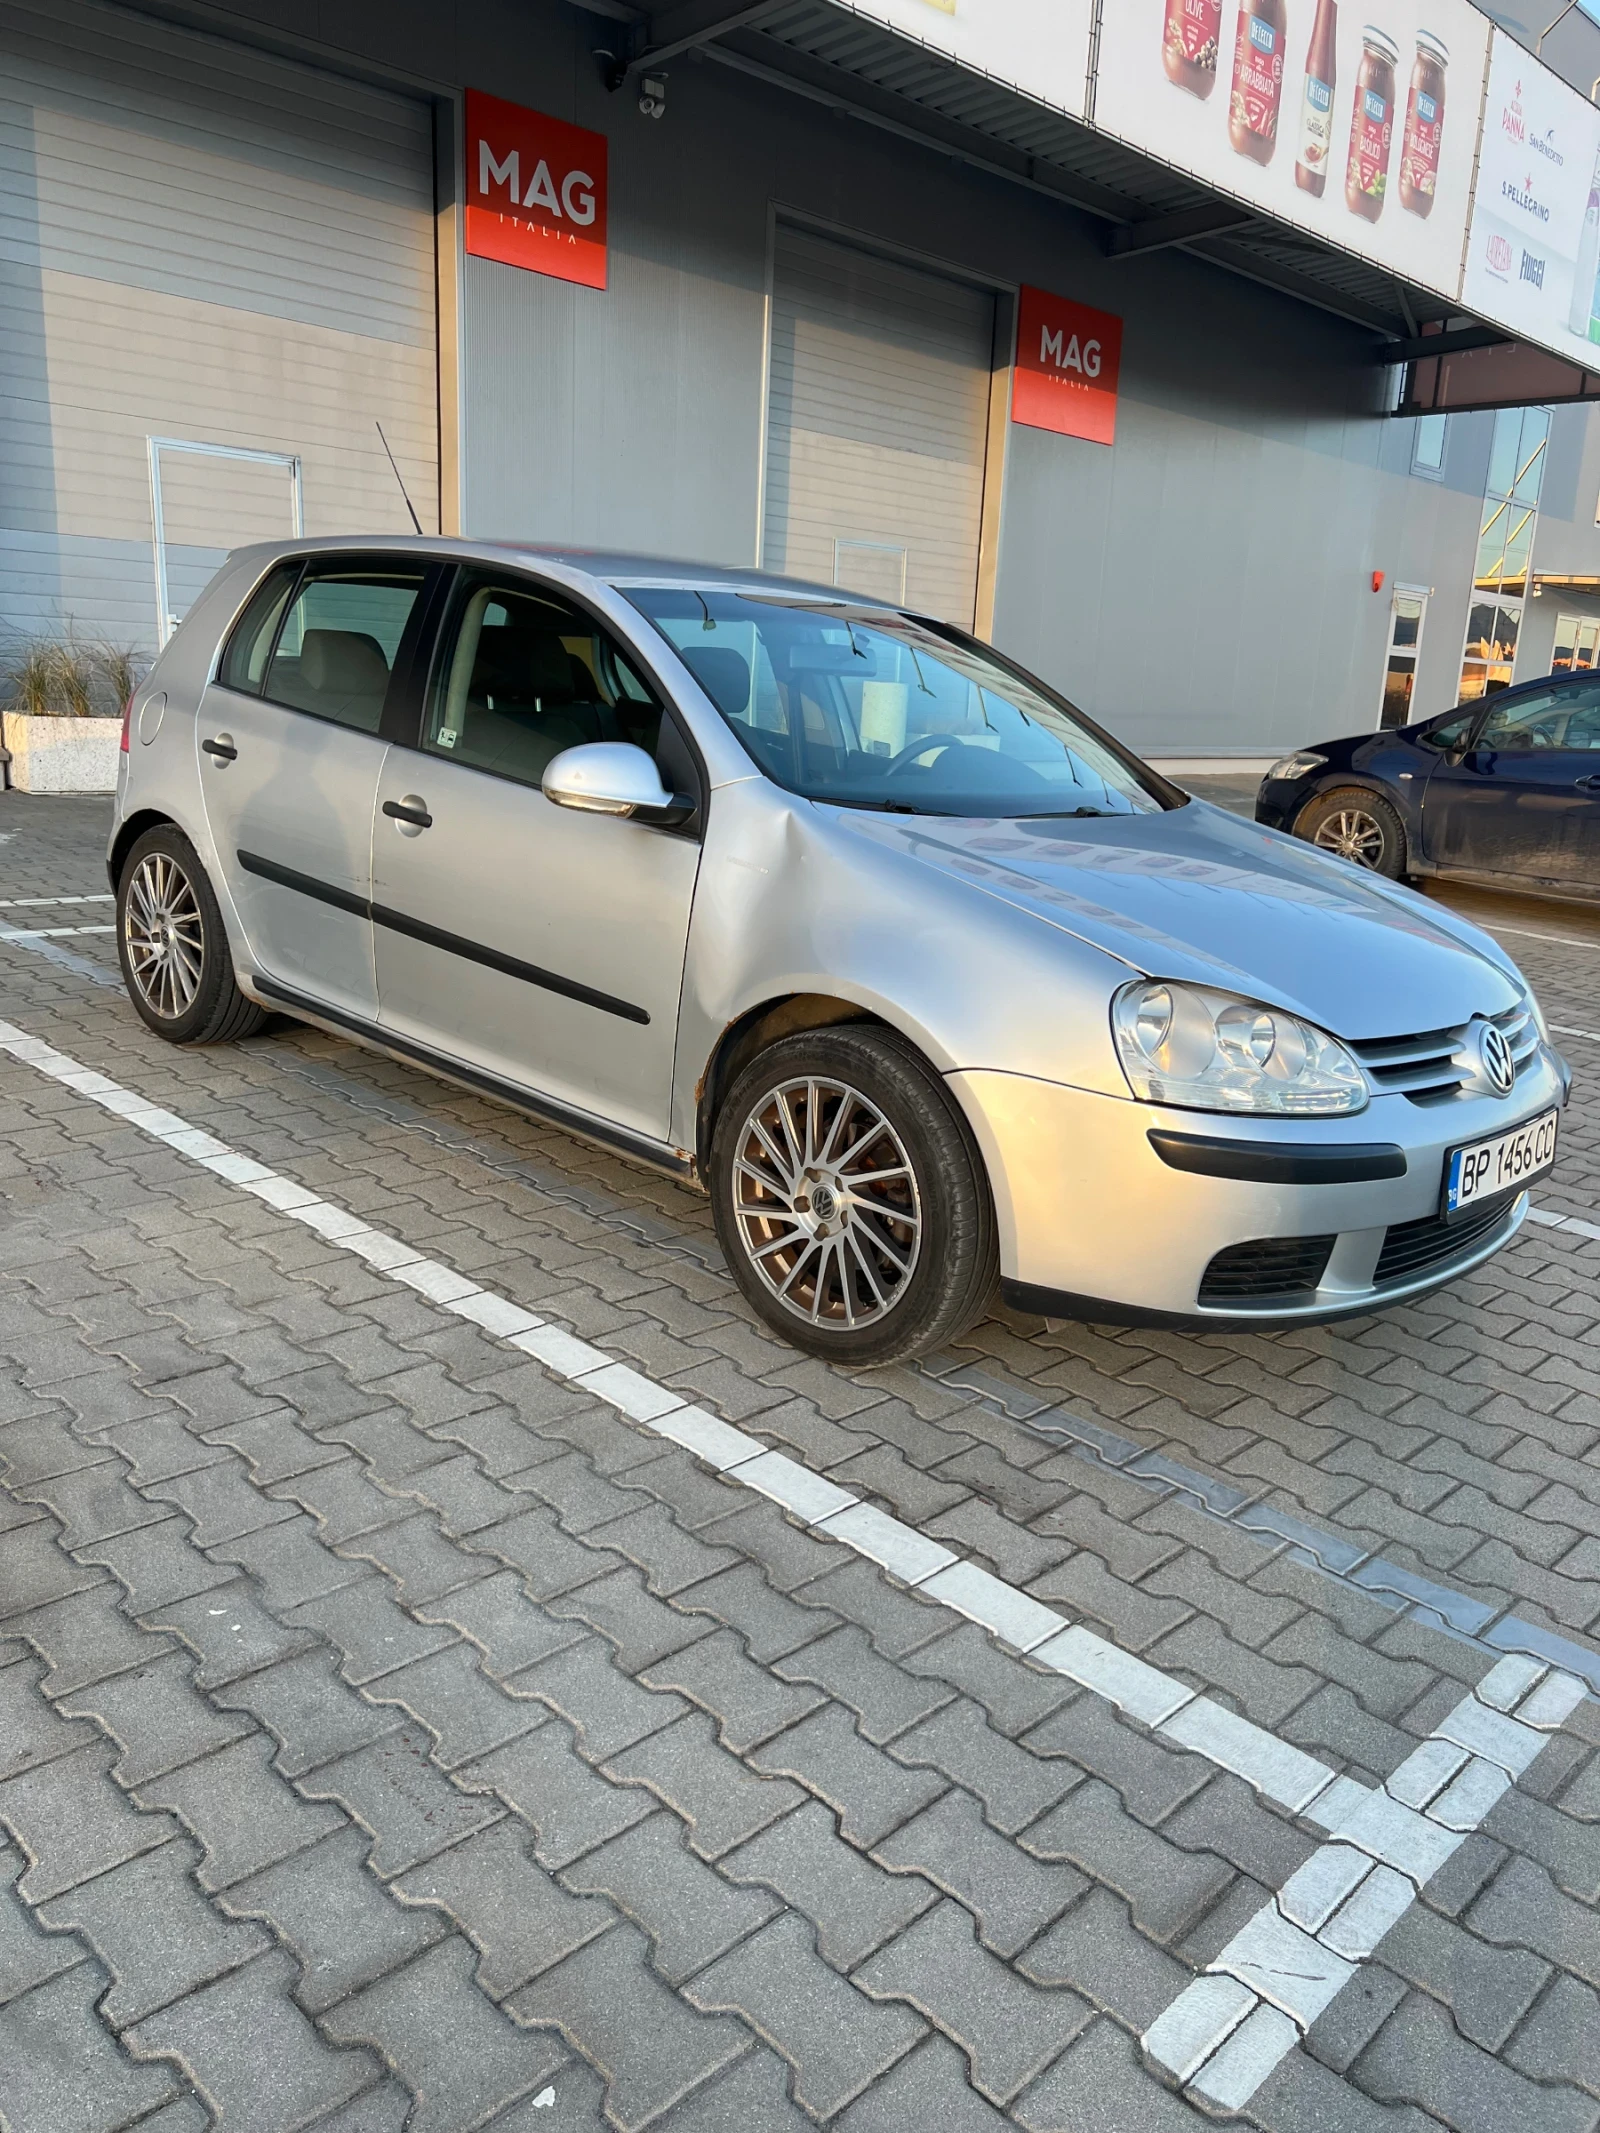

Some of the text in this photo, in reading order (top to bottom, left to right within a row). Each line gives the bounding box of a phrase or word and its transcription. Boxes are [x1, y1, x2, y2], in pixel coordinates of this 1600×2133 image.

[1502, 107, 1525, 143] PANNA
[479, 139, 596, 226] MAG
[500, 213, 577, 245] ITALIA
[1519, 248, 1546, 290] FIUGGI
[1040, 324, 1102, 378] MAG
[1048, 374, 1089, 392] ITALIA
[1462, 1119, 1554, 1198] BP 1456 CC
